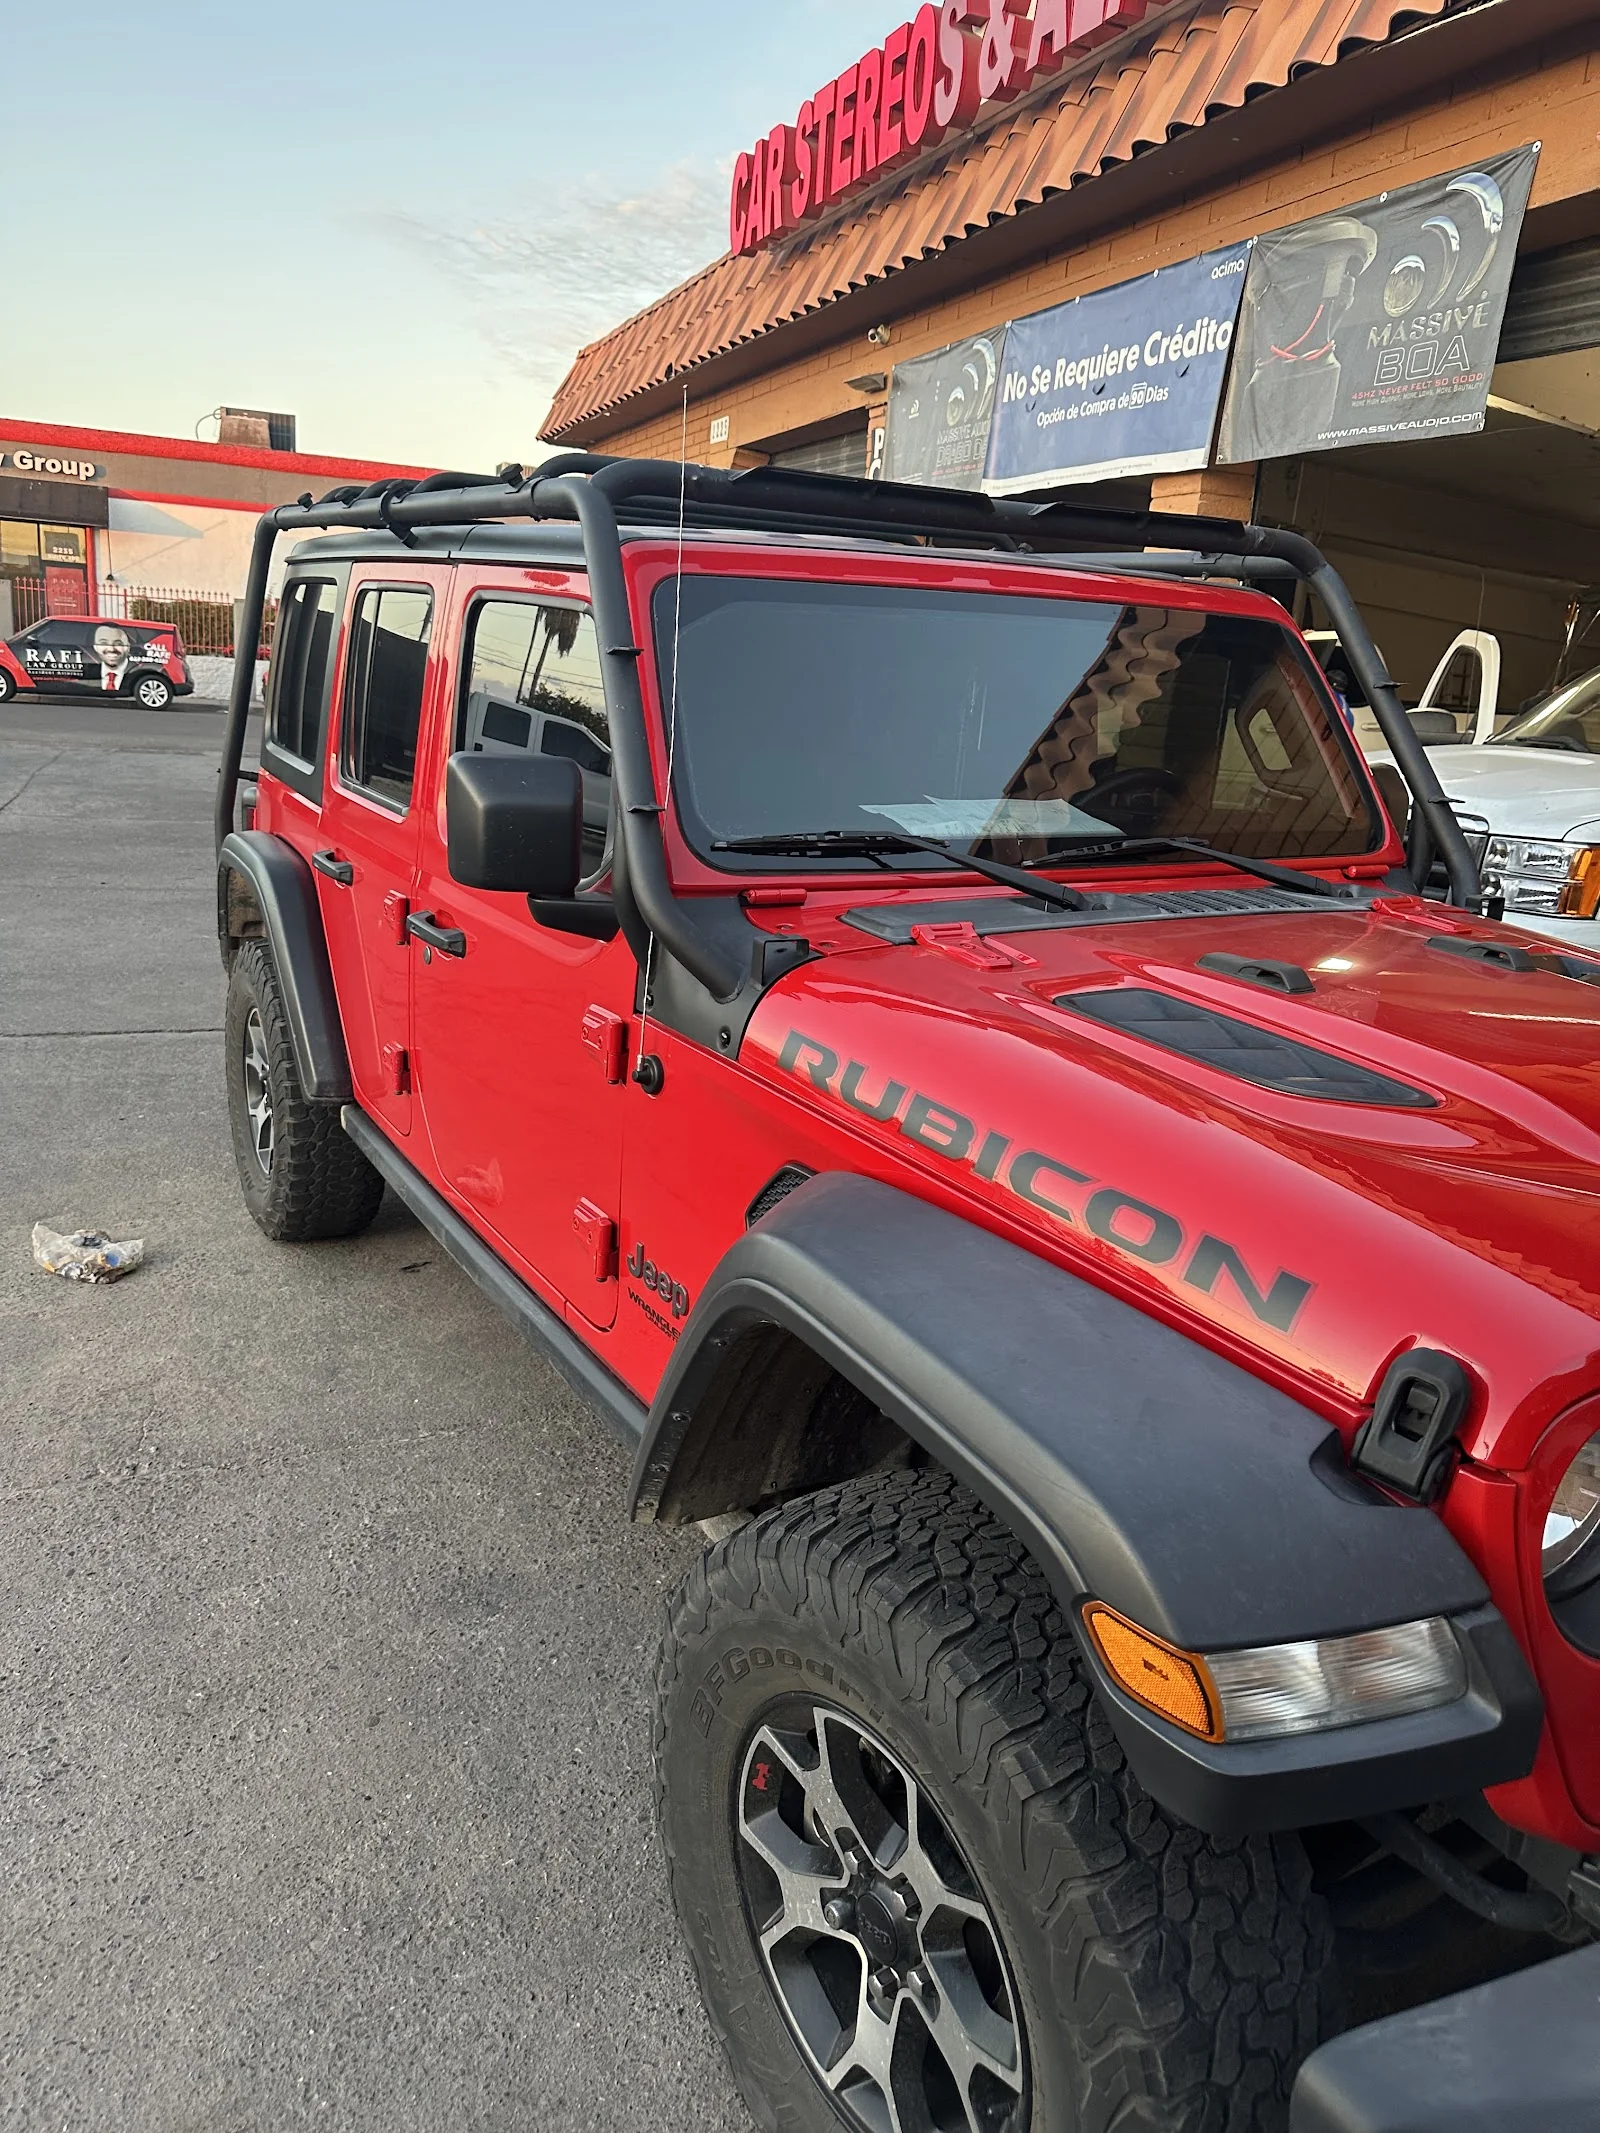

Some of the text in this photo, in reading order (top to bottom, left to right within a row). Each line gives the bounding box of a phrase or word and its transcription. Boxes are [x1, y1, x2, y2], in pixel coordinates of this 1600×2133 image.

[730, 124, 787, 256] CAR
[791, 0, 972, 219] STEREOS
[979, 0, 1015, 98] &
[1211, 258, 1245, 280] acima
[1366, 298, 1491, 351] MASSIVE
[1003, 316, 1234, 402] No Se Requiere Crédito
[1374, 335, 1470, 386] BOA
[1352, 372, 1486, 400] 45HZ NEVER FELT SO GOOD!
[1036, 406, 1065, 428] Opción
[1067, 403, 1078, 420] de
[1080, 398, 1116, 417] Compra
[1118, 392, 1129, 408] de
[1131, 391, 1144, 405] 90
[13, 450, 96, 480] Group
[26, 648, 82, 663] RAFI
[51, 662, 83, 670] GROUP
[144, 643, 167, 651] CALL
[776, 1029, 1313, 1333] RUBICON
[627, 1241, 690, 1319] Jeep
[628, 1286, 681, 1340] WRANGLE
